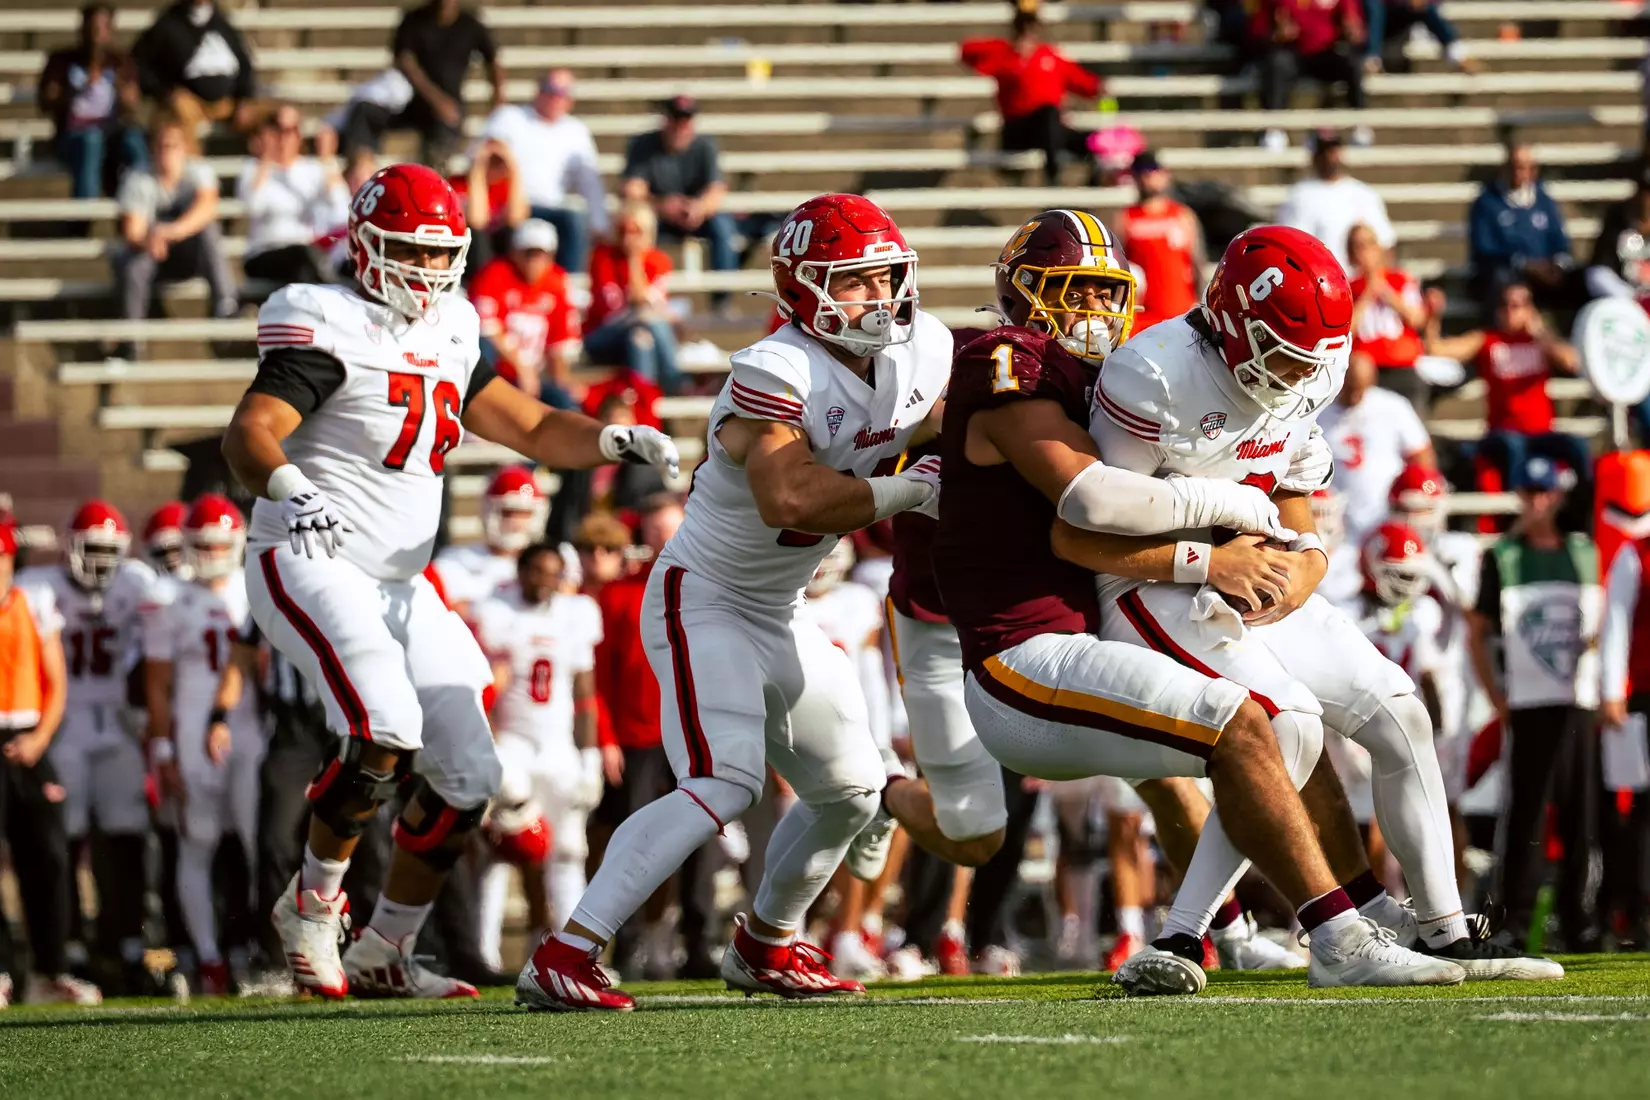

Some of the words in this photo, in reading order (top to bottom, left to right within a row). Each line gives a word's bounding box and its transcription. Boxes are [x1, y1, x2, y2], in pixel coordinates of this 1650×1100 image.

[779, 219, 814, 256] 20
[1249, 266, 1284, 301] 6
[990, 344, 1020, 394] 1
[382, 371, 461, 477] 76
[853, 418, 899, 451] Miami
[1236, 431, 1291, 460] Miami
[1341, 434, 1363, 470] 3
[530, 658, 552, 703] 0
